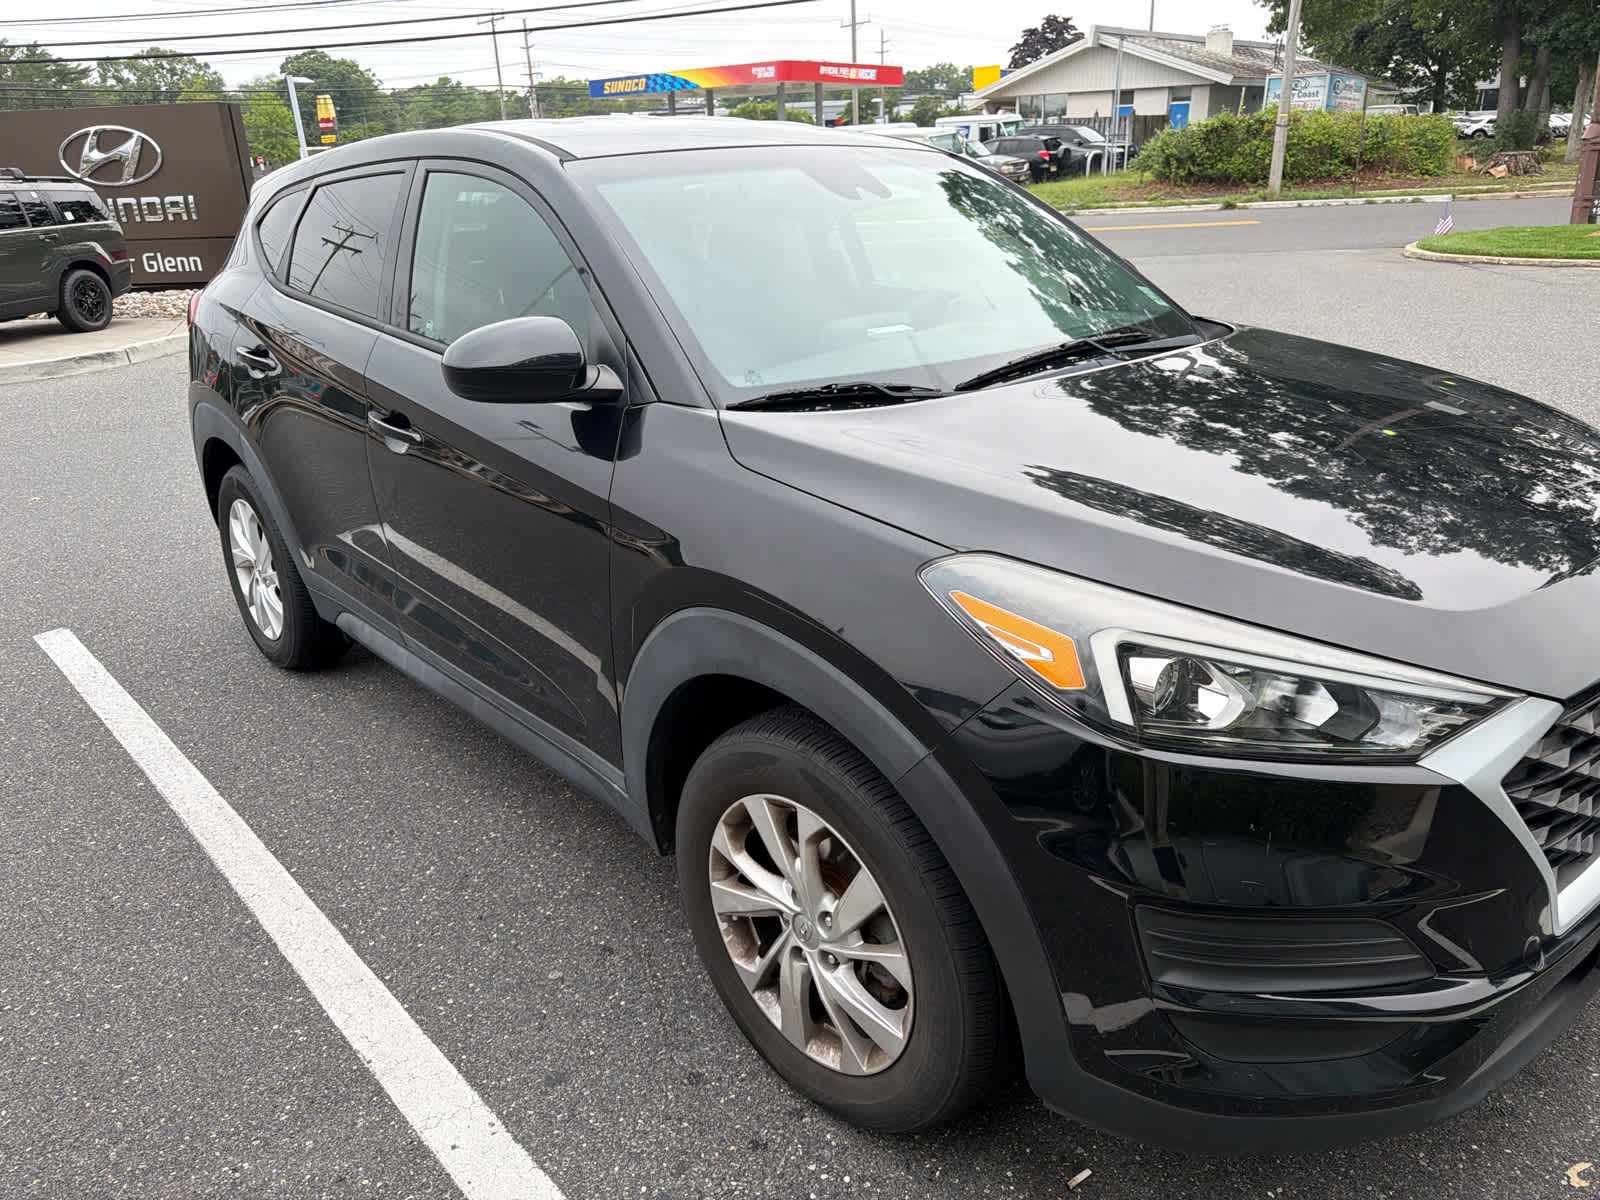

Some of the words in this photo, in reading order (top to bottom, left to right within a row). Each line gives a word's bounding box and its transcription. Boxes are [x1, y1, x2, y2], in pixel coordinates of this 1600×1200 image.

[603, 78, 647, 94] SUNOCO
[107, 195, 198, 222] NDAI
[142, 252, 203, 272] Glenn
